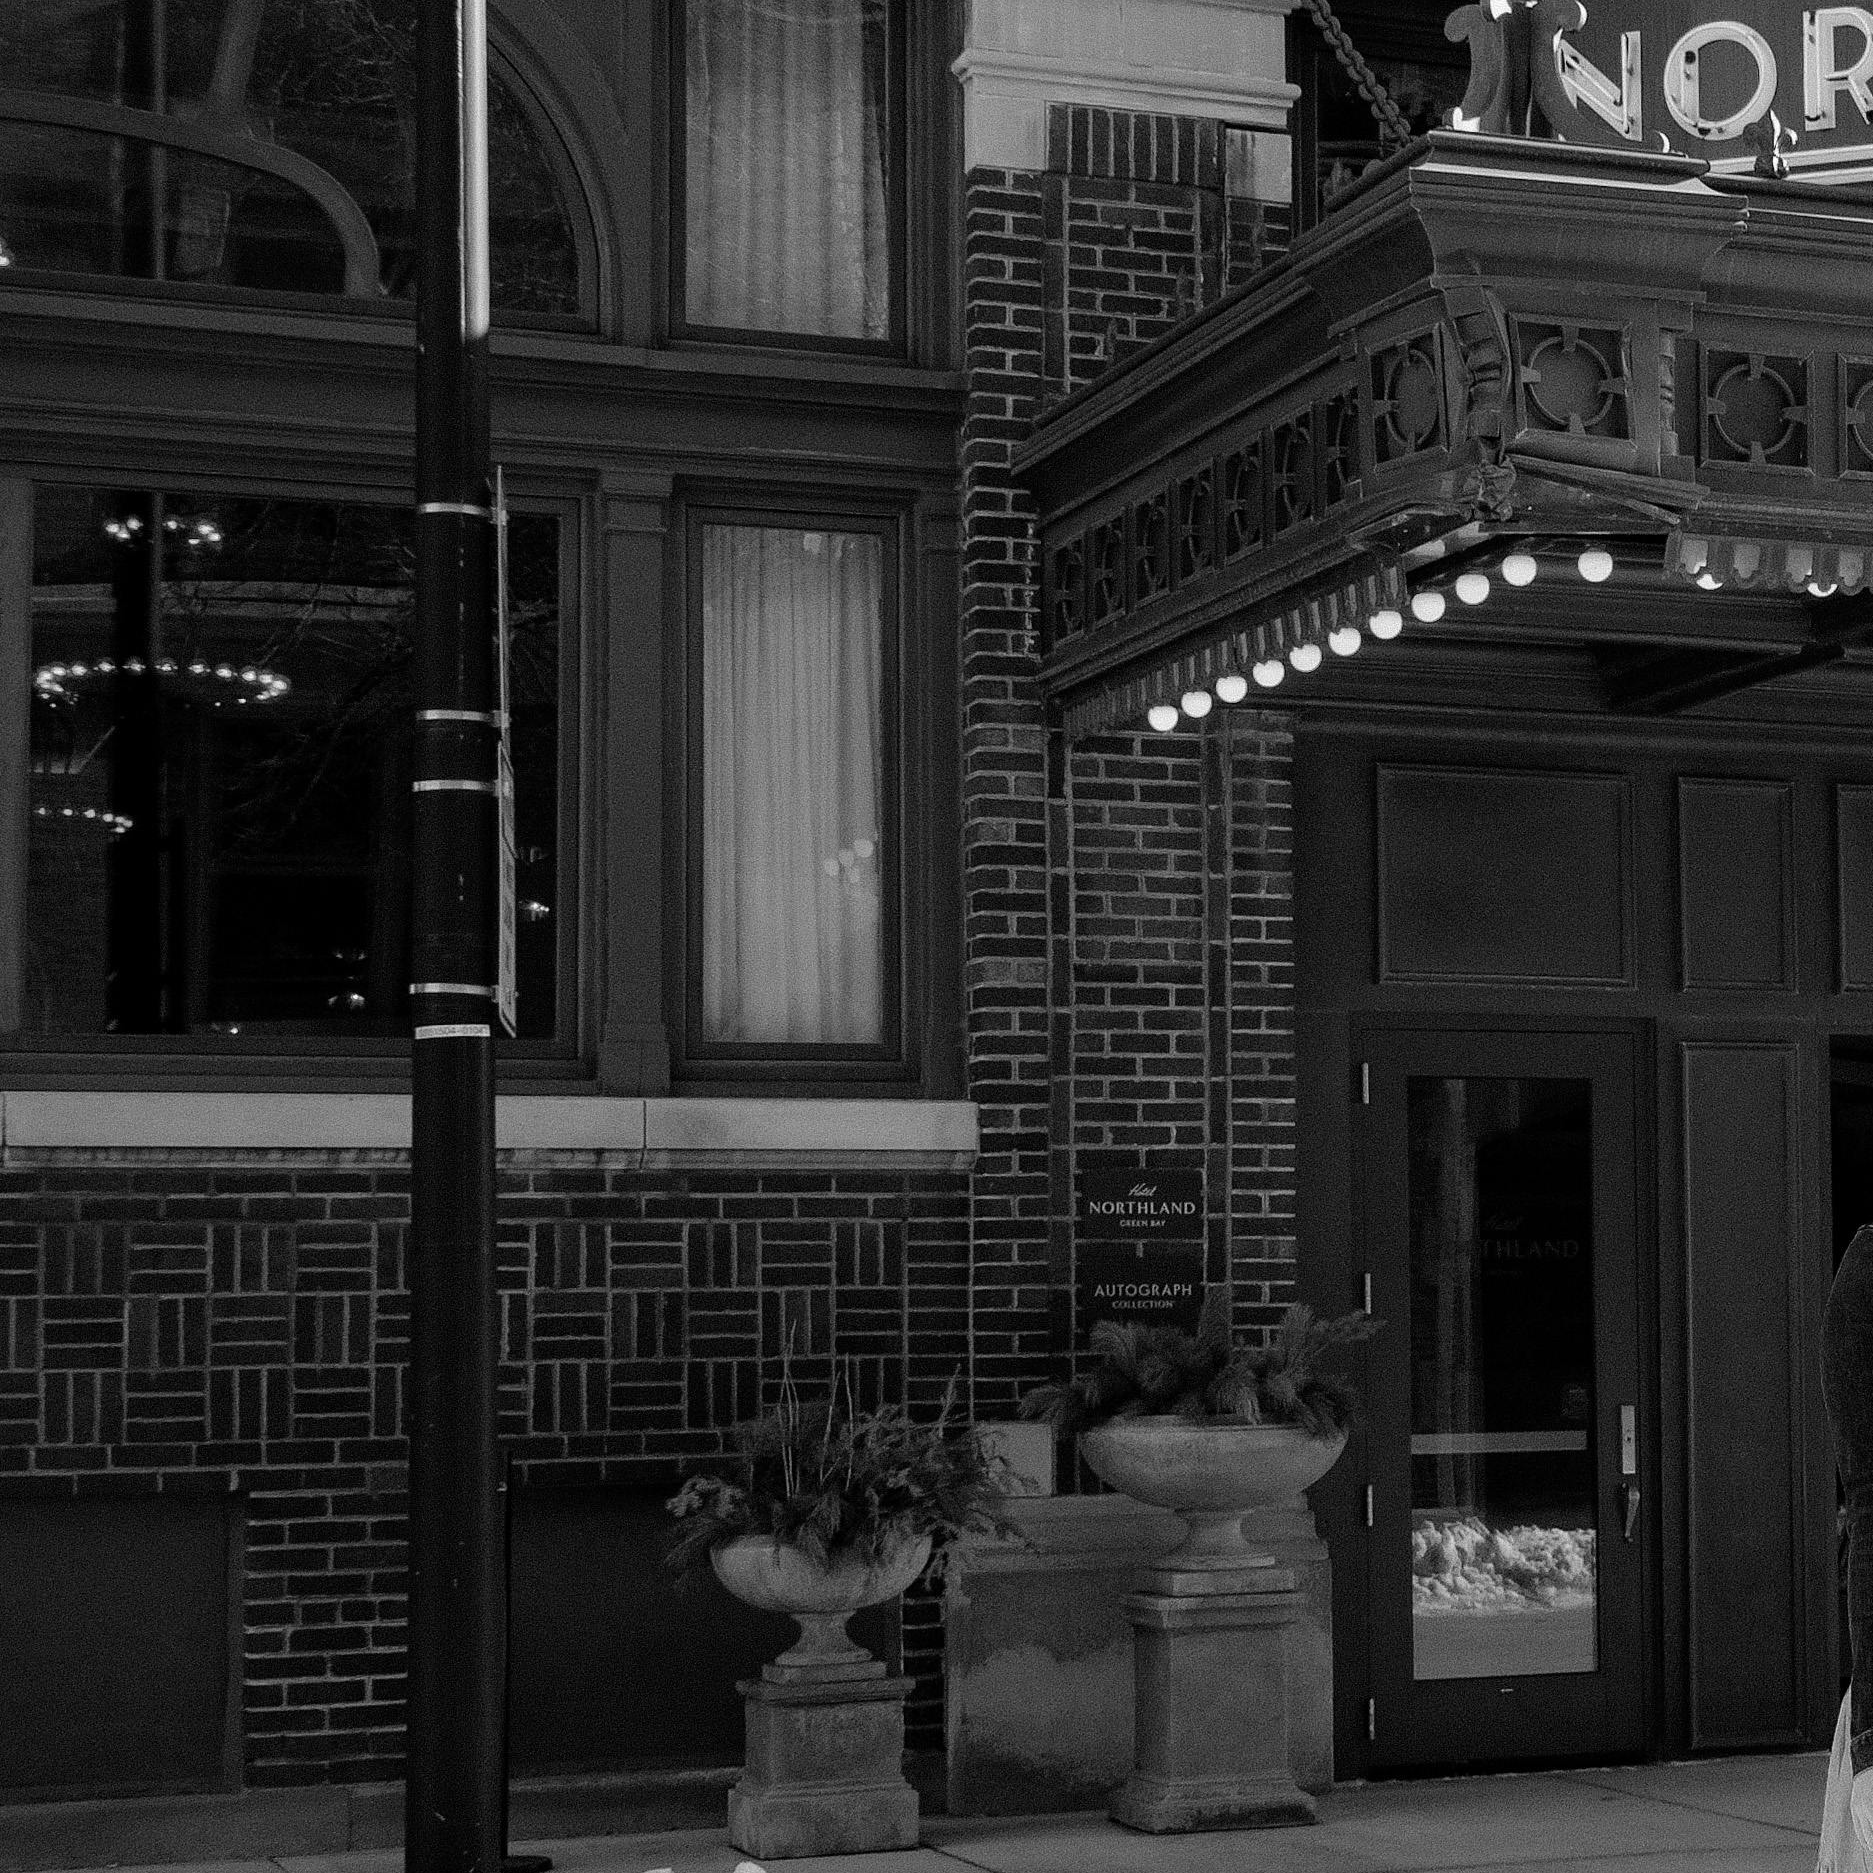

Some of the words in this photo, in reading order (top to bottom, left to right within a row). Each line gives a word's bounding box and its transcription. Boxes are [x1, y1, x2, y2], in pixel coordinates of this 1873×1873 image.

[1089, 1201, 1196, 1215] NORTHLAND
[1119, 1219, 1148, 1227] GREEN
[1150, 1219, 1166, 1227] BAY
[1481, 1238, 1580, 1259] THLAND
[1094, 1283, 1192, 1297] AUTOGRAPH
[1111, 1300, 1175, 1309] COLLECTION
